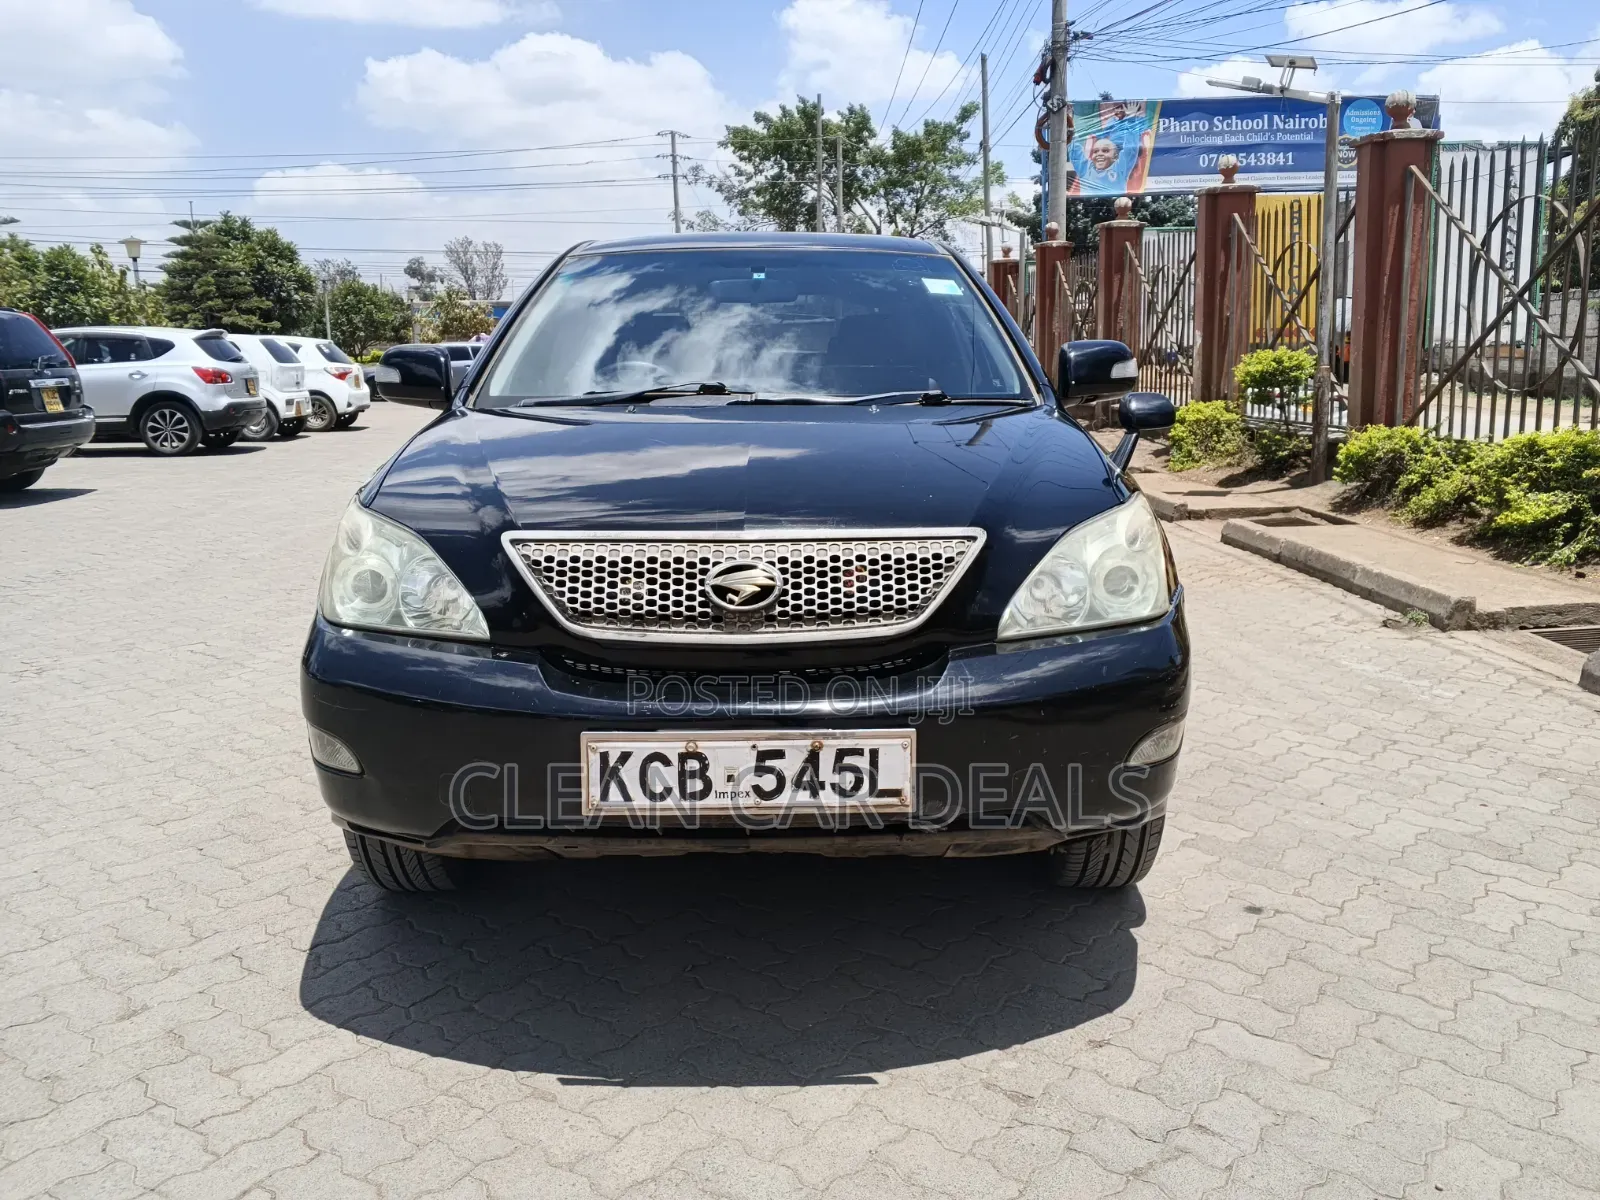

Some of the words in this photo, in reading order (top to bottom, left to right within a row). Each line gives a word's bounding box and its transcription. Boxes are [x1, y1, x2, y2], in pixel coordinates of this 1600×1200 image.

[1158, 117, 1209, 133] Pharo
[1213, 114, 1269, 131] School
[1272, 113, 1328, 129] Nairob
[1350, 116, 1377, 124] Ongoing
[1180, 134, 1223, 145] Unlocking
[1224, 133, 1245, 142] Each
[1246, 132, 1275, 142] Child's
[1276, 131, 1314, 141] Potential
[1199, 152, 1295, 168] 07543841
[1337, 150, 1357, 158] NOW
[599, 751, 714, 802] KCB
[751, 747, 905, 801] 545L
[714, 789, 751, 801] Impex
